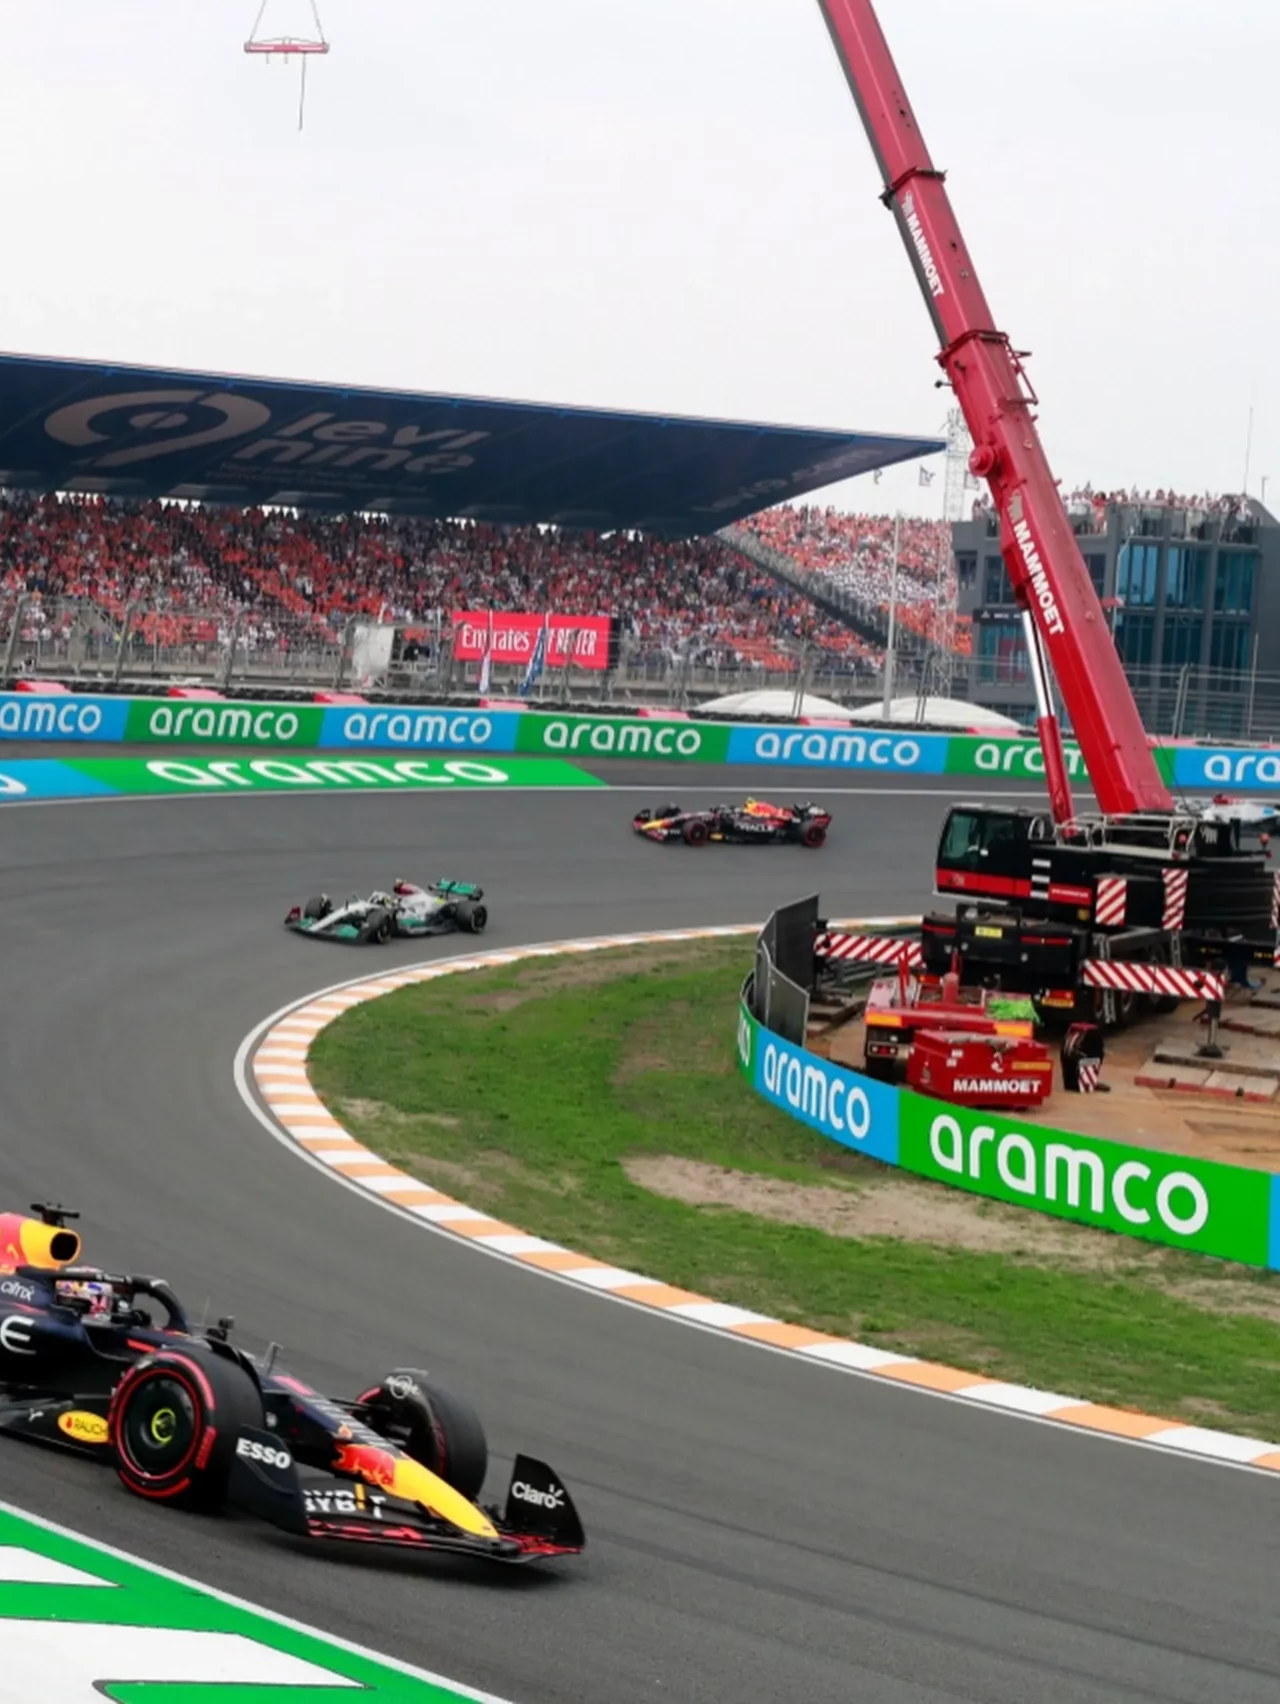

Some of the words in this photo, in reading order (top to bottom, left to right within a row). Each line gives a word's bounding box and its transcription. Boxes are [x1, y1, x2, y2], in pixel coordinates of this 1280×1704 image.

[906, 211, 945, 298] MAMMOET
[274, 411, 492, 450] levi
[232, 438, 476, 474] nine
[1013, 519, 1065, 636] MAMMOET
[461, 624, 530, 653] Emrates
[149, 707, 299, 740] aramco
[343, 714, 492, 744] aramco
[543, 722, 702, 755] aramco
[755, 733, 921, 767] aramco
[145, 759, 509, 787] aramco
[764, 1043, 870, 1140] aramco
[952, 1078, 1042, 1094] MAMMOET
[928, 1113, 1210, 1237] aramco
[236, 1437, 292, 1470] ESSO
[511, 1480, 559, 1510] Claro
